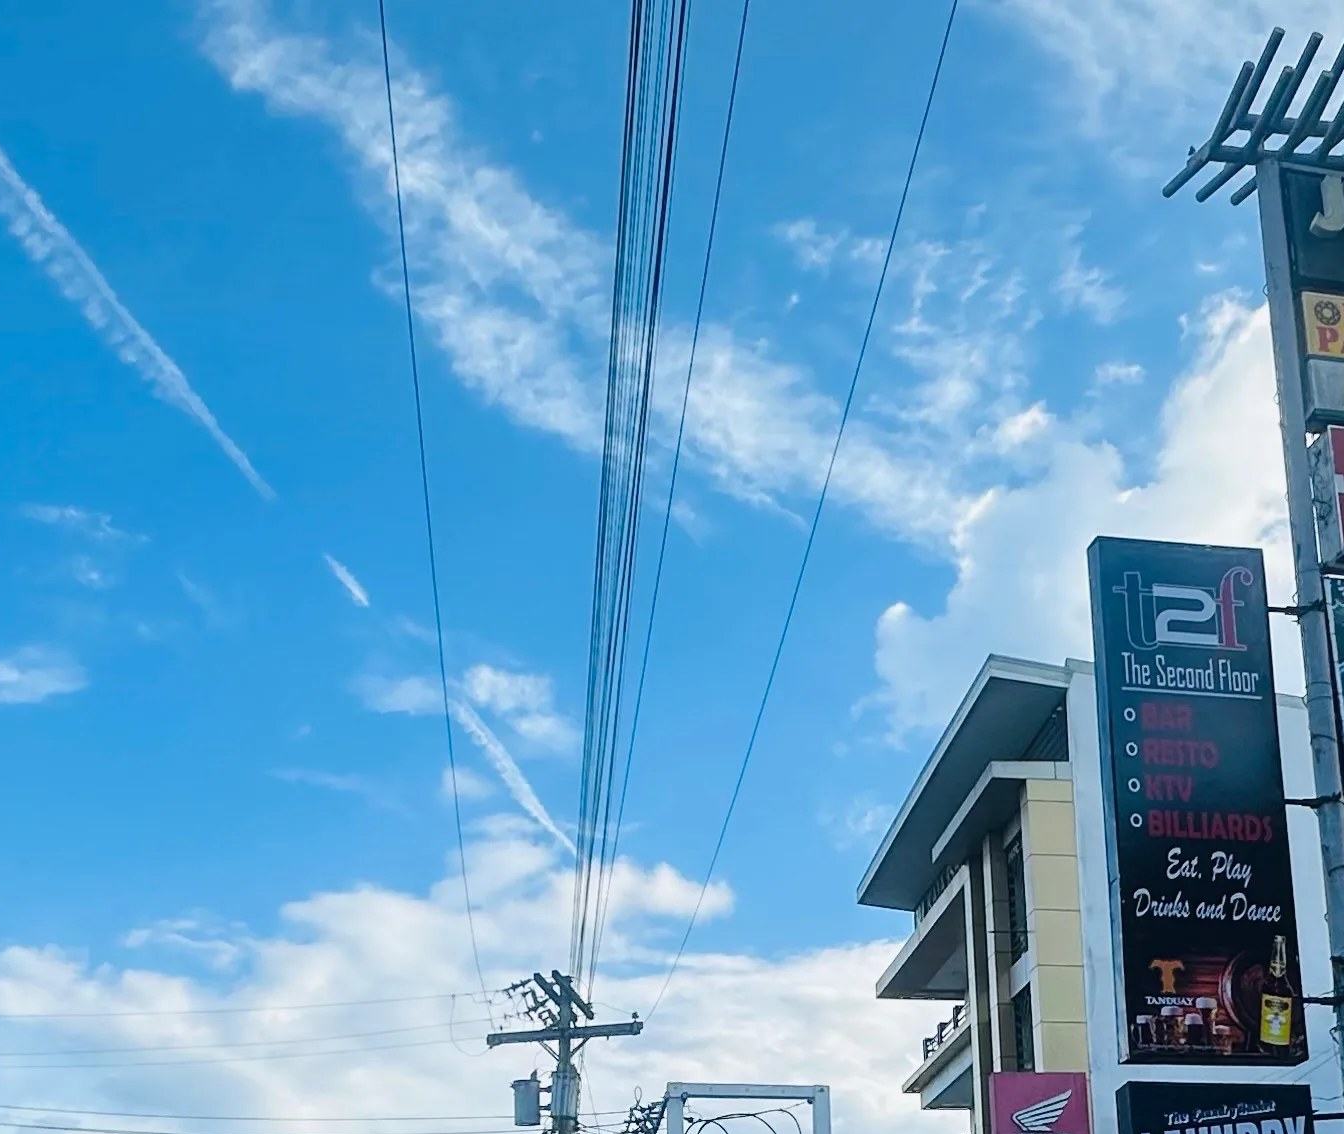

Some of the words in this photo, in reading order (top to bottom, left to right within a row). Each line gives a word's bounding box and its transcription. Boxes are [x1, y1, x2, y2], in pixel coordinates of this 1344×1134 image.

[1121, 652, 1151, 686] The
[1156, 654, 1214, 691] Second
[1218, 659, 1260, 693] Floor
[1140, 701, 1194, 732] BAR
[1143, 737, 1220, 769] RESTO
[1143, 772, 1195, 802] KTV
[1147, 808, 1273, 843] BILLIARDS
[1210, 850, 1253, 888] Play
[1133, 888, 1191, 918] Drinks
[1196, 894, 1227, 920] and
[1230, 892, 1282, 923] Dance
[1144, 995, 1196, 1007] TANDUAY
